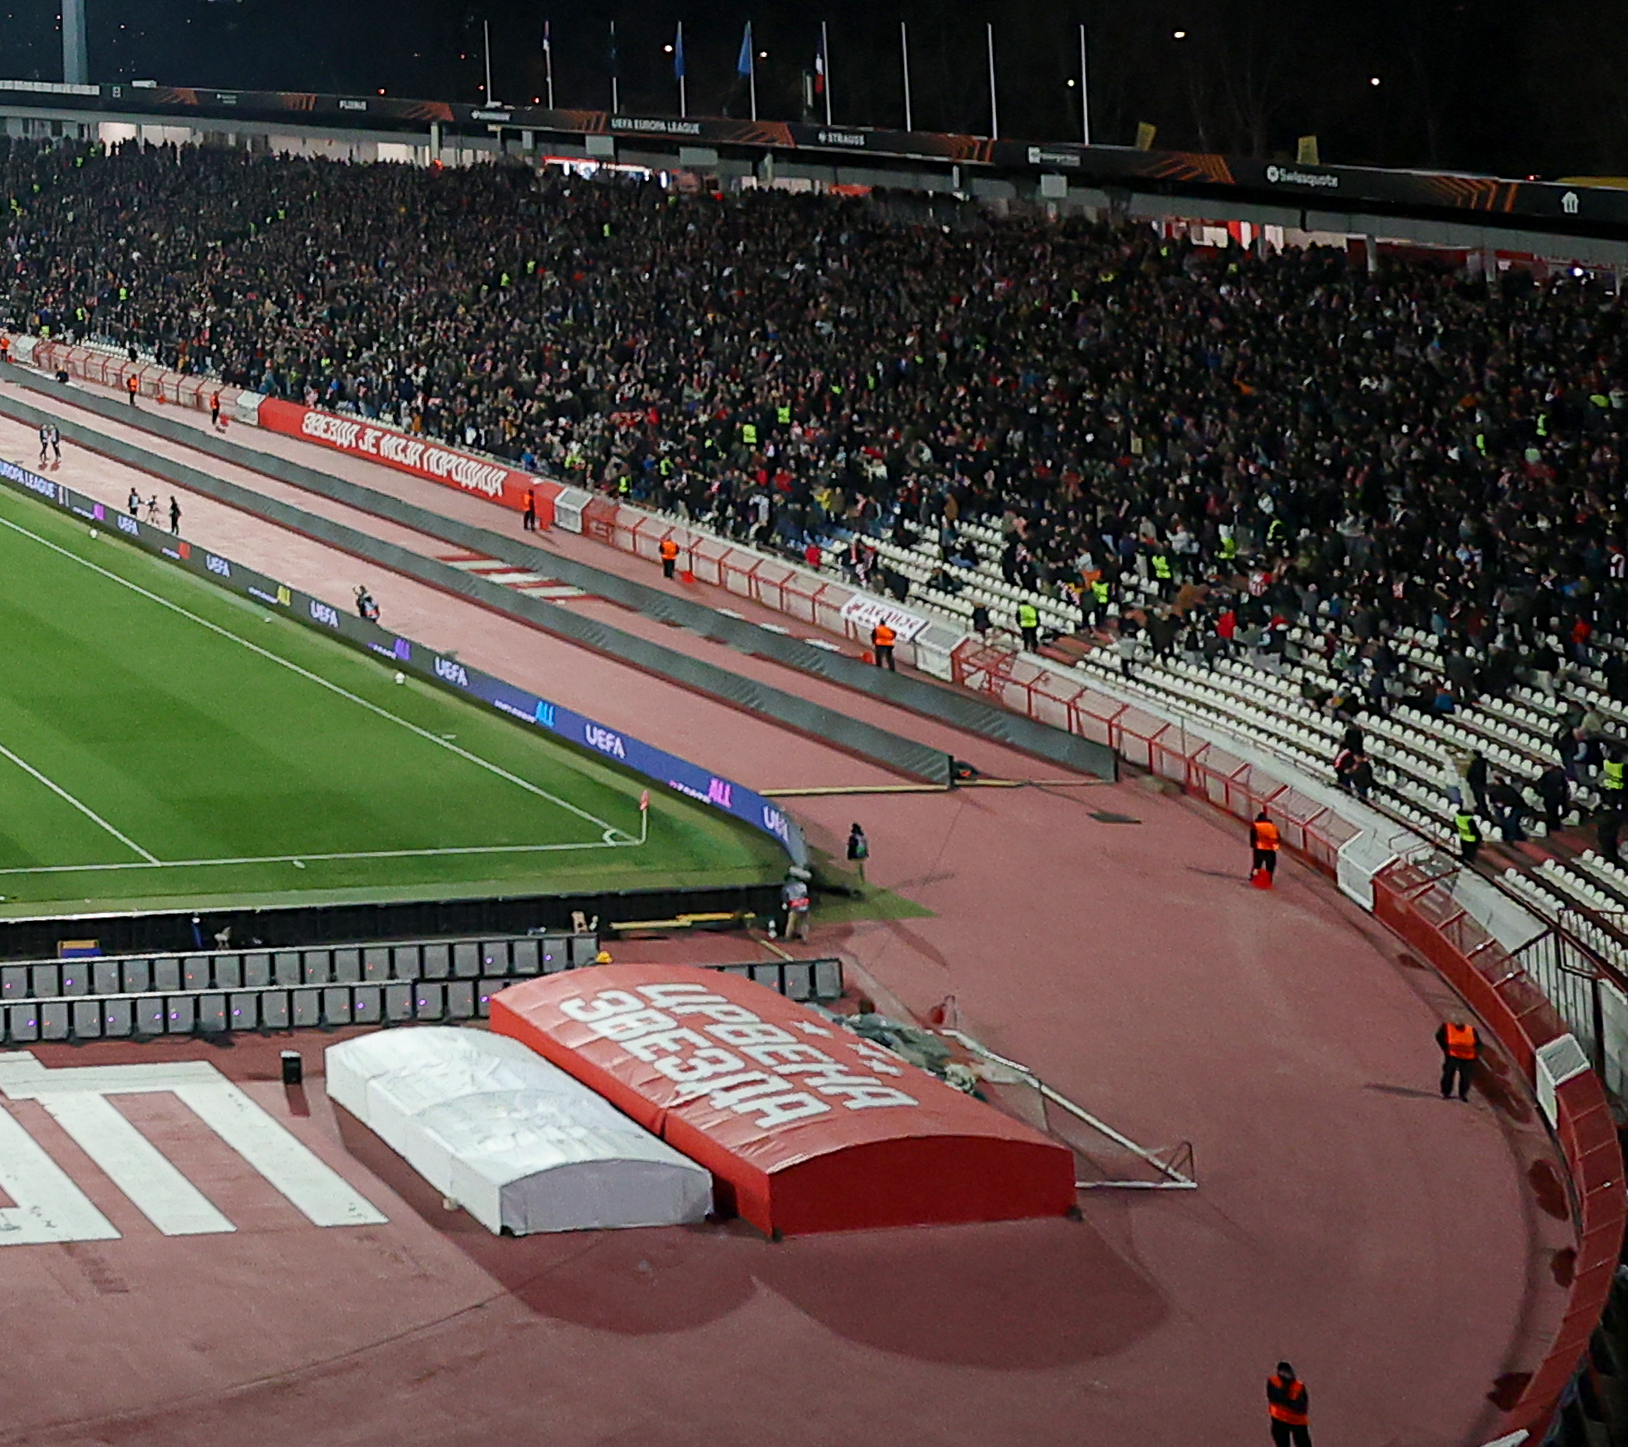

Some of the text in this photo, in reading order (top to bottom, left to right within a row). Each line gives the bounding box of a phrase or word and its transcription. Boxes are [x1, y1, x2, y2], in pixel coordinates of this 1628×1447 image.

[302, 412, 361, 449] ЗВЕЗДА
[424, 447, 509, 498] ПОРОДИЦА
[25, 470, 57, 499] LEAGUE
[117, 513, 140, 537] UEFA
[206, 553, 231, 578] UEFA
[309, 599, 340, 629] UEFA
[434, 655, 468, 687] UEFA
[585, 722, 626, 760] UEFA
[708, 776, 733, 809] ALL
[558, 990, 832, 1131] ЗВЕЗДА
[636, 982, 919, 1112] ЦРВЕНА
